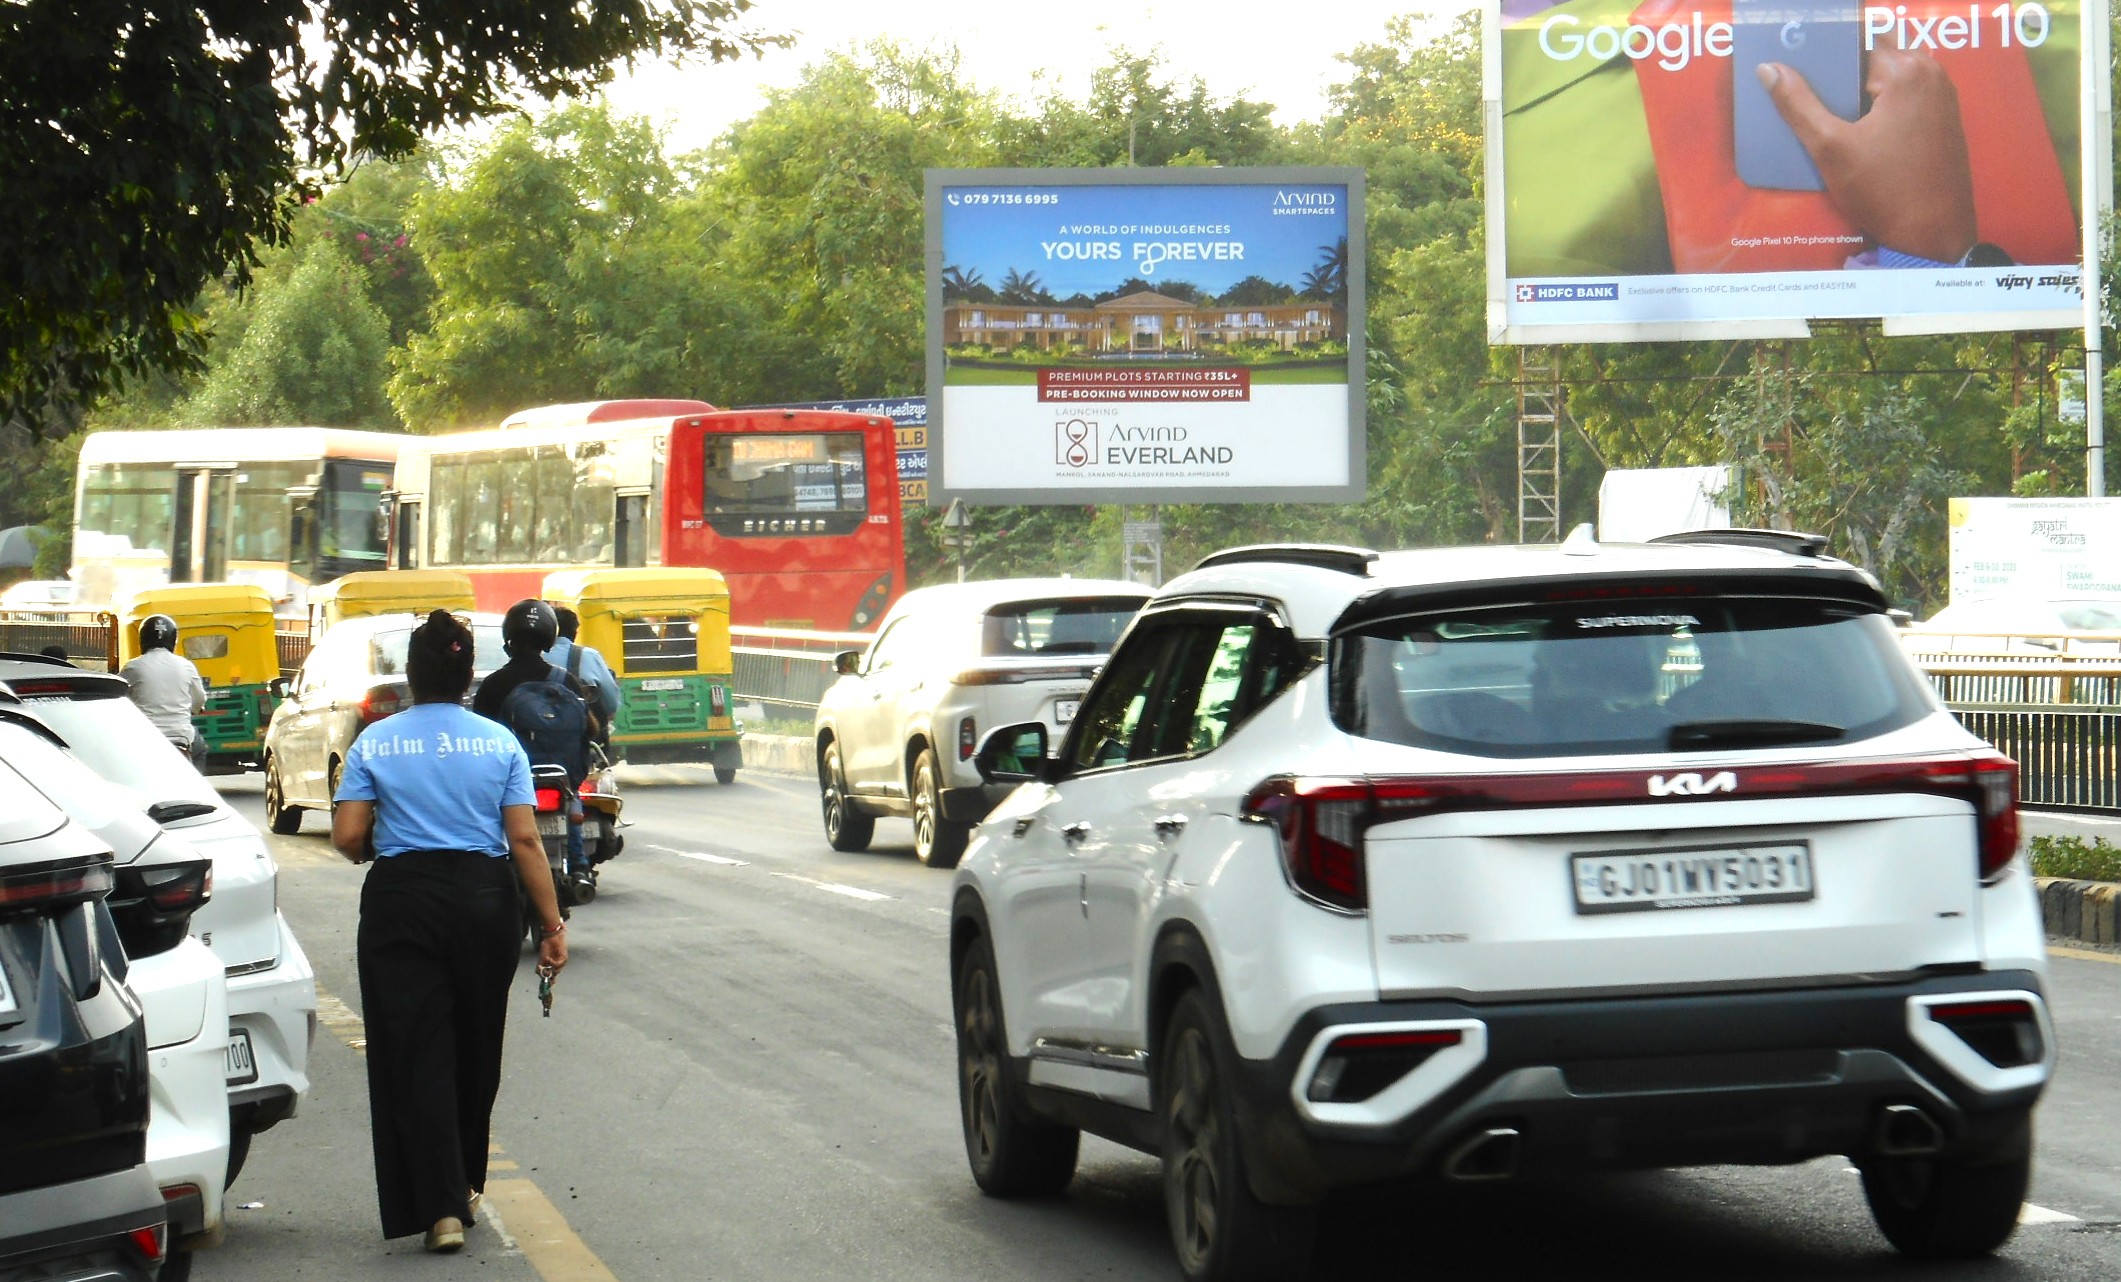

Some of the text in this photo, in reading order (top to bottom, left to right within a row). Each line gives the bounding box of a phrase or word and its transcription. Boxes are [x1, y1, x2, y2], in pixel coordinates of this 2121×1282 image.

[1864, 2, 2049, 51] Pixel 10
[1538, 11, 1734, 72] Google
[964, 193, 1059, 205] 079 7136 6995
[1273, 208, 1336, 216] SMARTSPACES
[1059, 224, 1231, 235] A WORLD OF INDULGENCES
[1731, 234, 1864, 249] Google Pixel 10 Pro phone shown
[1041, 241, 1245, 276] YOURS FOREVER
[1704, 285, 1728, 294] HDFC
[1729, 285, 1750, 293] Bank
[1751, 283, 1776, 293] Credit
[1778, 282, 1803, 292] Cards
[1803, 282, 1819, 291] and
[1935, 278, 1986, 288] Available at:
[1996, 273, 2034, 291] vijay
[1538, 287, 1614, 299] HDFC BANK
[1049, 372, 1102, 382] PREMIUM
[1105, 372, 1142, 381] PLOTS
[1144, 371, 1203, 381] STARTING
[1046, 388, 1243, 399] PRE-BOOKING WINDOW NOW OPEN
[1055, 408, 1119, 416] LAUNCHING
[1107, 447, 1233, 465] EVERLAND
[361, 732, 517, 761] Palm Angels
